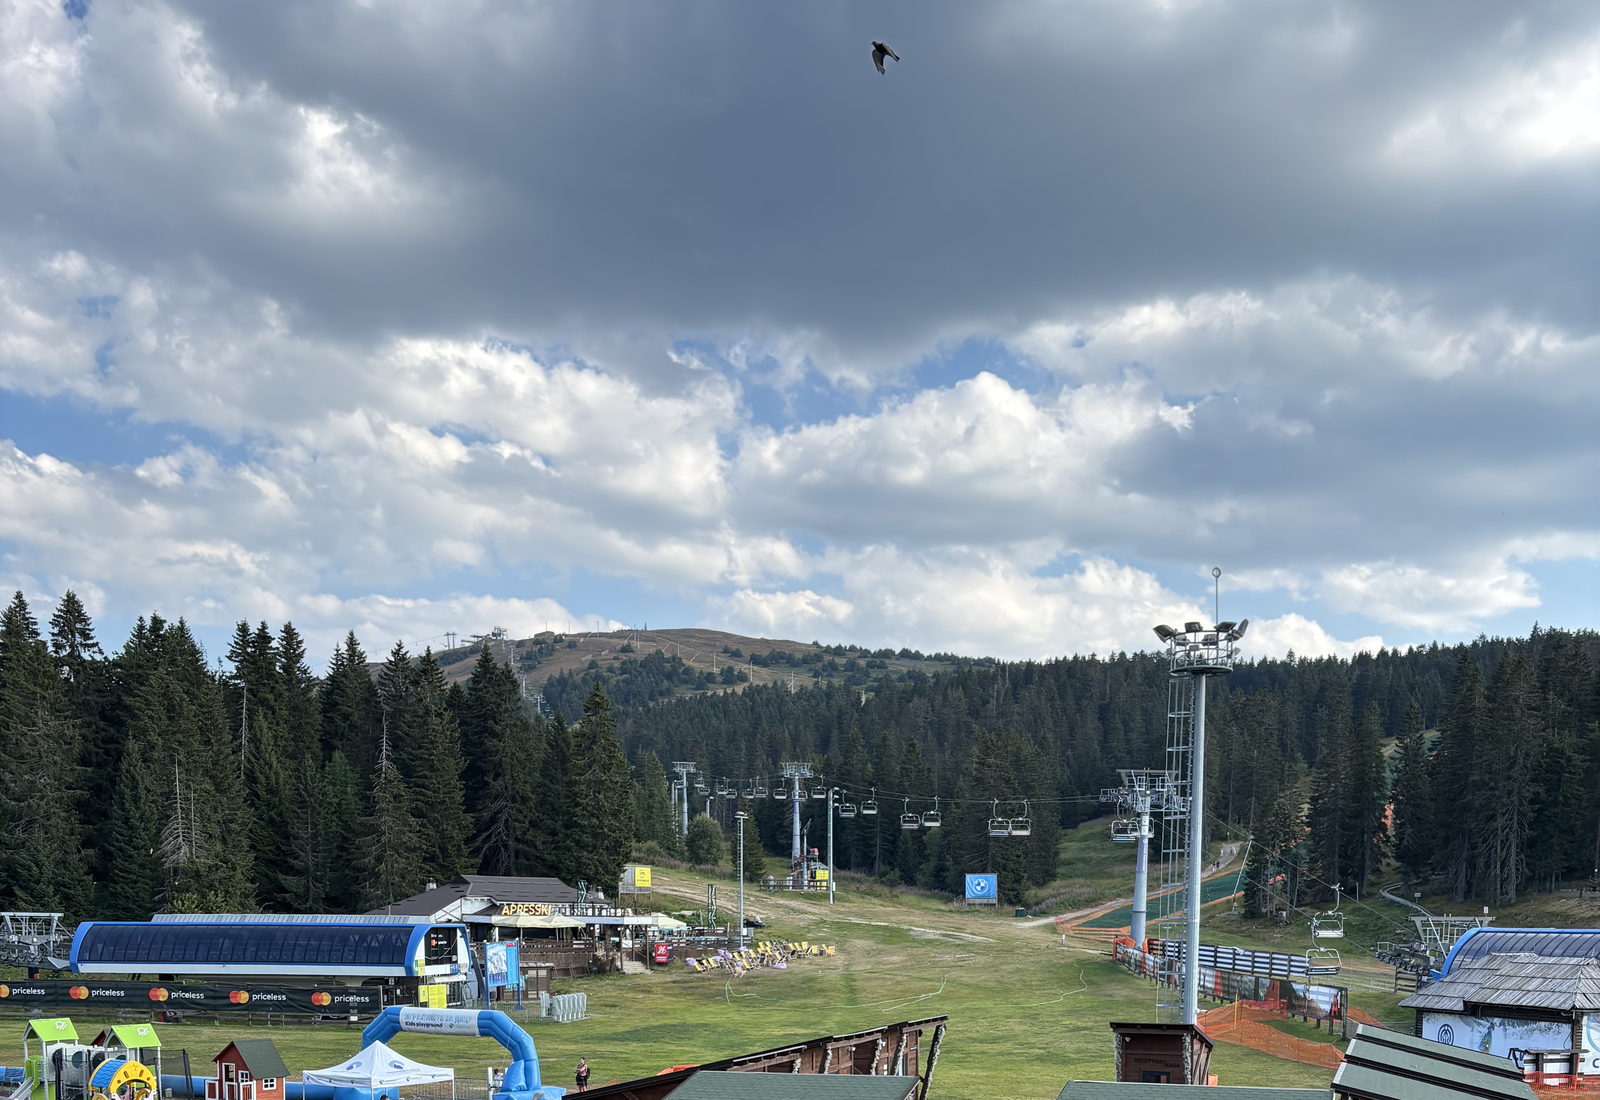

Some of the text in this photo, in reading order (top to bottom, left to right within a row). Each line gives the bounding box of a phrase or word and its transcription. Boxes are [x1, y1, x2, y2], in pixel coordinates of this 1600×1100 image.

[501, 904, 552, 916] APRESSKI
[12, 987, 46, 996] priceless
[91, 988, 125, 998] priceless
[171, 990, 205, 1000] priceless
[252, 992, 287, 1002] priceless
[334, 994, 370, 1004] priceless
